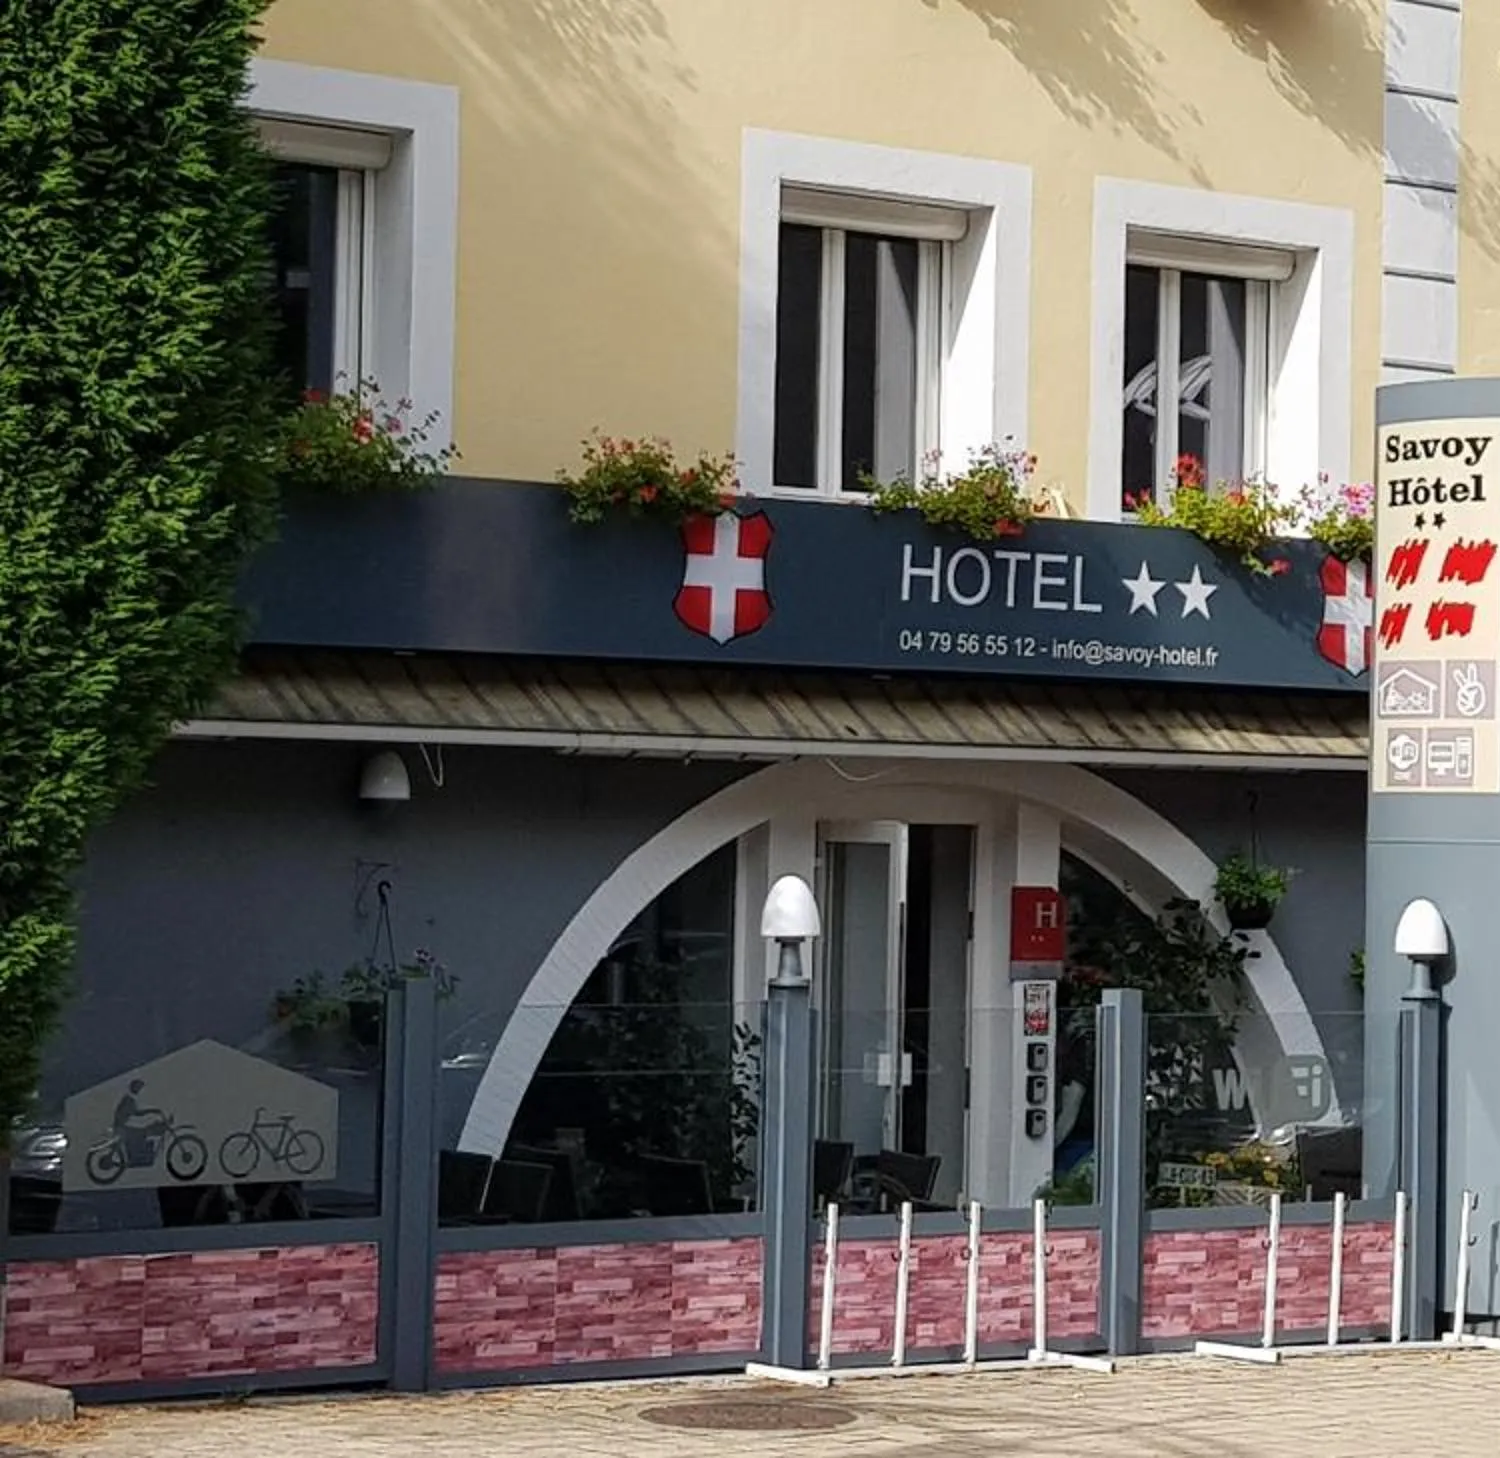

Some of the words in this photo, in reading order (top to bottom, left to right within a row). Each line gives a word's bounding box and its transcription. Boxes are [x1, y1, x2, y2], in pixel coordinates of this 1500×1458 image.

[1384, 435, 1492, 467] Savoy
[1388, 474, 1487, 508] Hôtel
[901, 543, 1103, 613] HOTEL
[899, 629, 922, 651] 04
[928, 631, 951, 653] 79
[956, 633, 980, 655] 56
[984, 635, 1008, 656] 55
[1014, 637, 1036, 658] 12
[1052, 638, 1219, 669] info@savoy-hotel.fr
[1035, 901, 1058, 929] H
